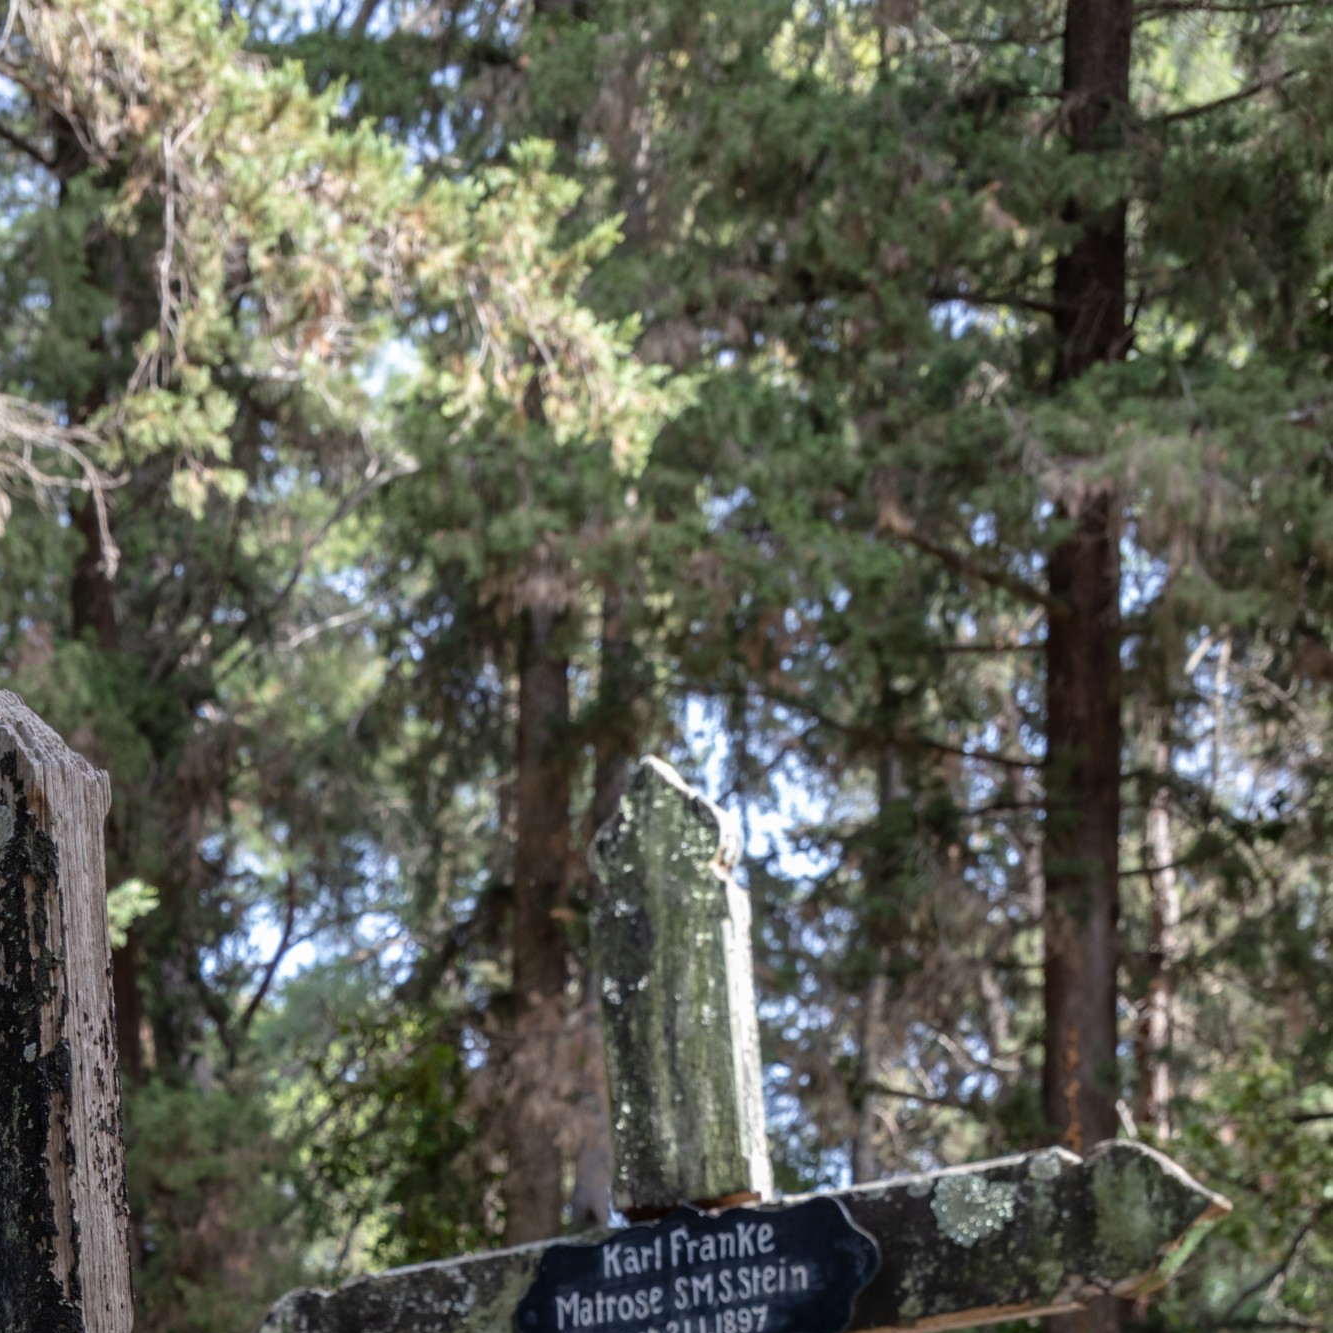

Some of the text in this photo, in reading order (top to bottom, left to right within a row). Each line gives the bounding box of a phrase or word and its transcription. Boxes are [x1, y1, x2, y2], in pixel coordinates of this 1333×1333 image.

[603, 1223, 776, 1279] Karl Franke
[555, 1286, 664, 1331] Matrose
[737, 1258, 809, 1301] Stein
